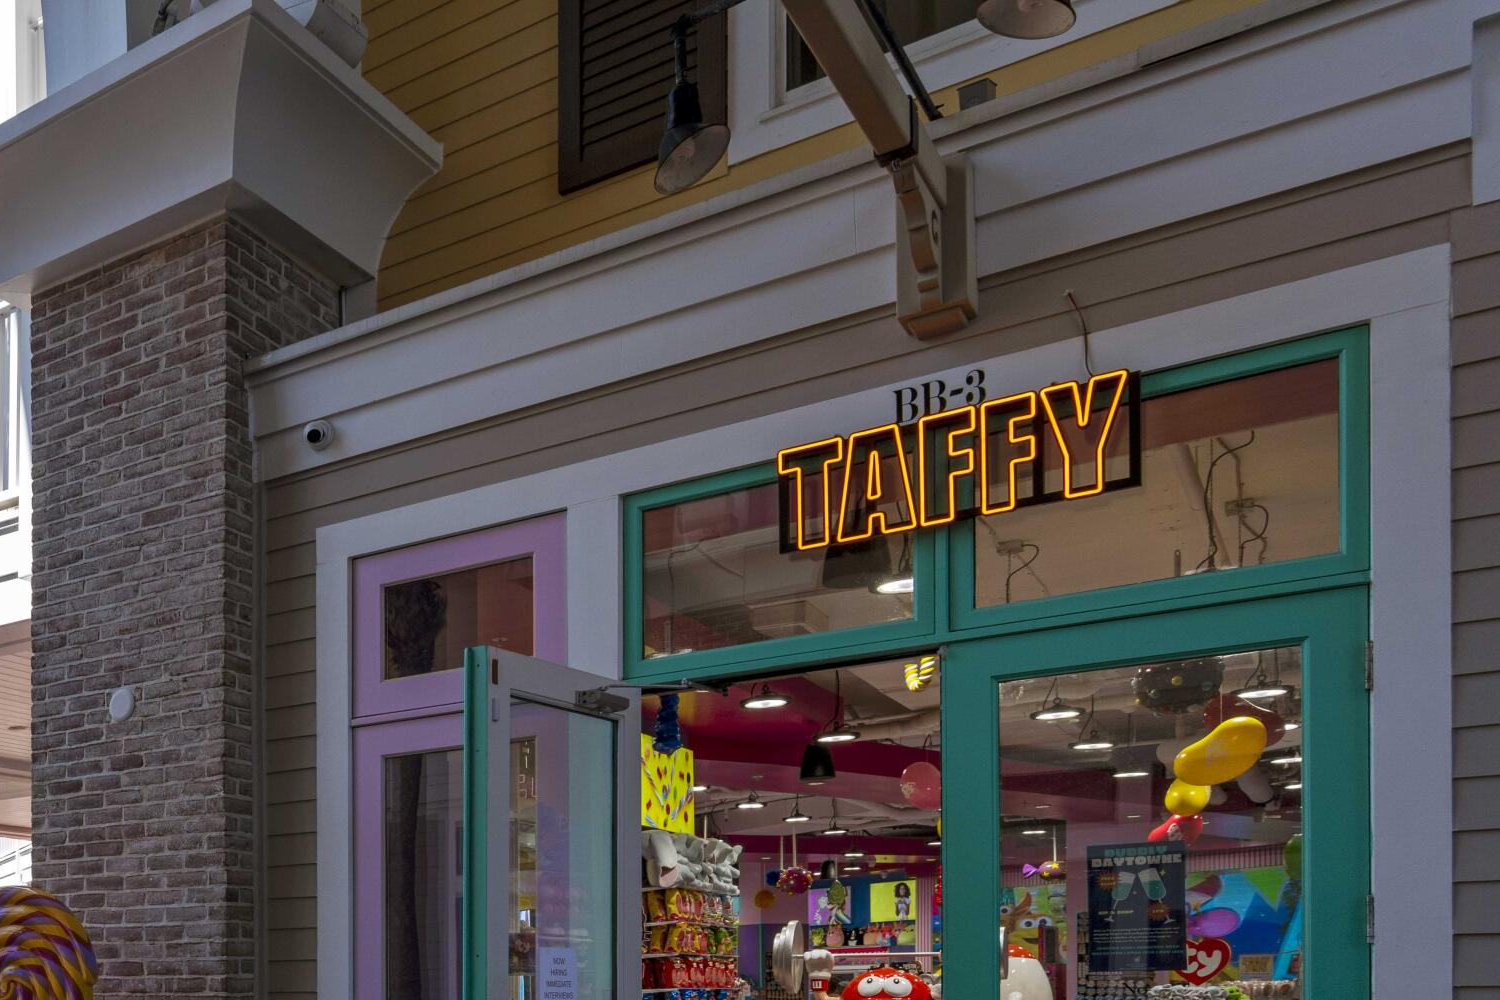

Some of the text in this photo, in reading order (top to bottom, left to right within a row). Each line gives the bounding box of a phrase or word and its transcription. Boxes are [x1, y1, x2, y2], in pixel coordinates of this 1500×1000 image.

[893, 369, 986, 423] BB-3
[777, 369, 1128, 550] TAFFY
[1091, 853, 1183, 868] BAYTOWNE
[553, 957, 566, 965] NOW
[550, 968, 568, 977] HIRING
[546, 980, 573, 988] IMMEDIATE
[1122, 981, 1149, 994] No
[543, 991, 574, 1000] INTERVIEWS
